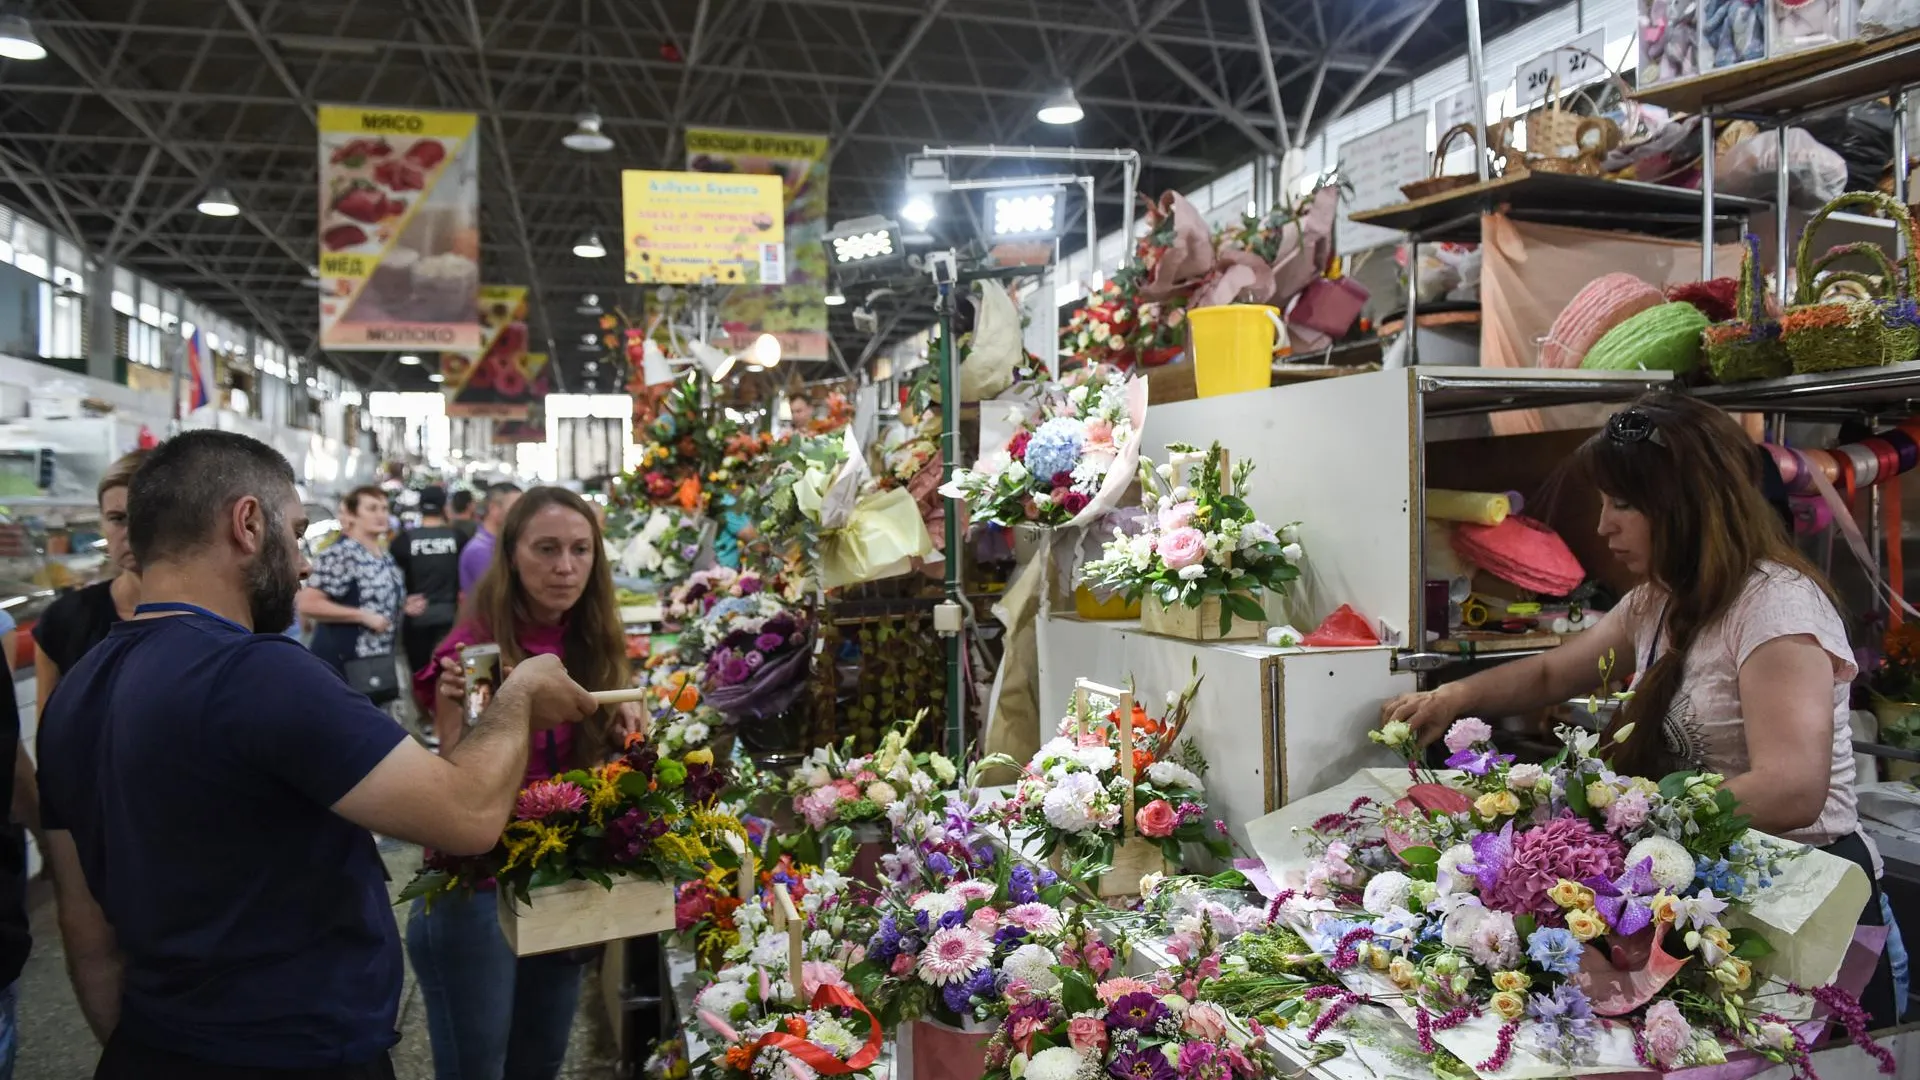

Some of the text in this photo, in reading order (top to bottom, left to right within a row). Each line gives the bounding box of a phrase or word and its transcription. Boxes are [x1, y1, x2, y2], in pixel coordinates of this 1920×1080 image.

[1569, 48, 1591, 72] 27
[1528, 68, 1548, 90] 26
[361, 113, 423, 132] МЯСО
[366, 327, 455, 342] МОЛОКО
